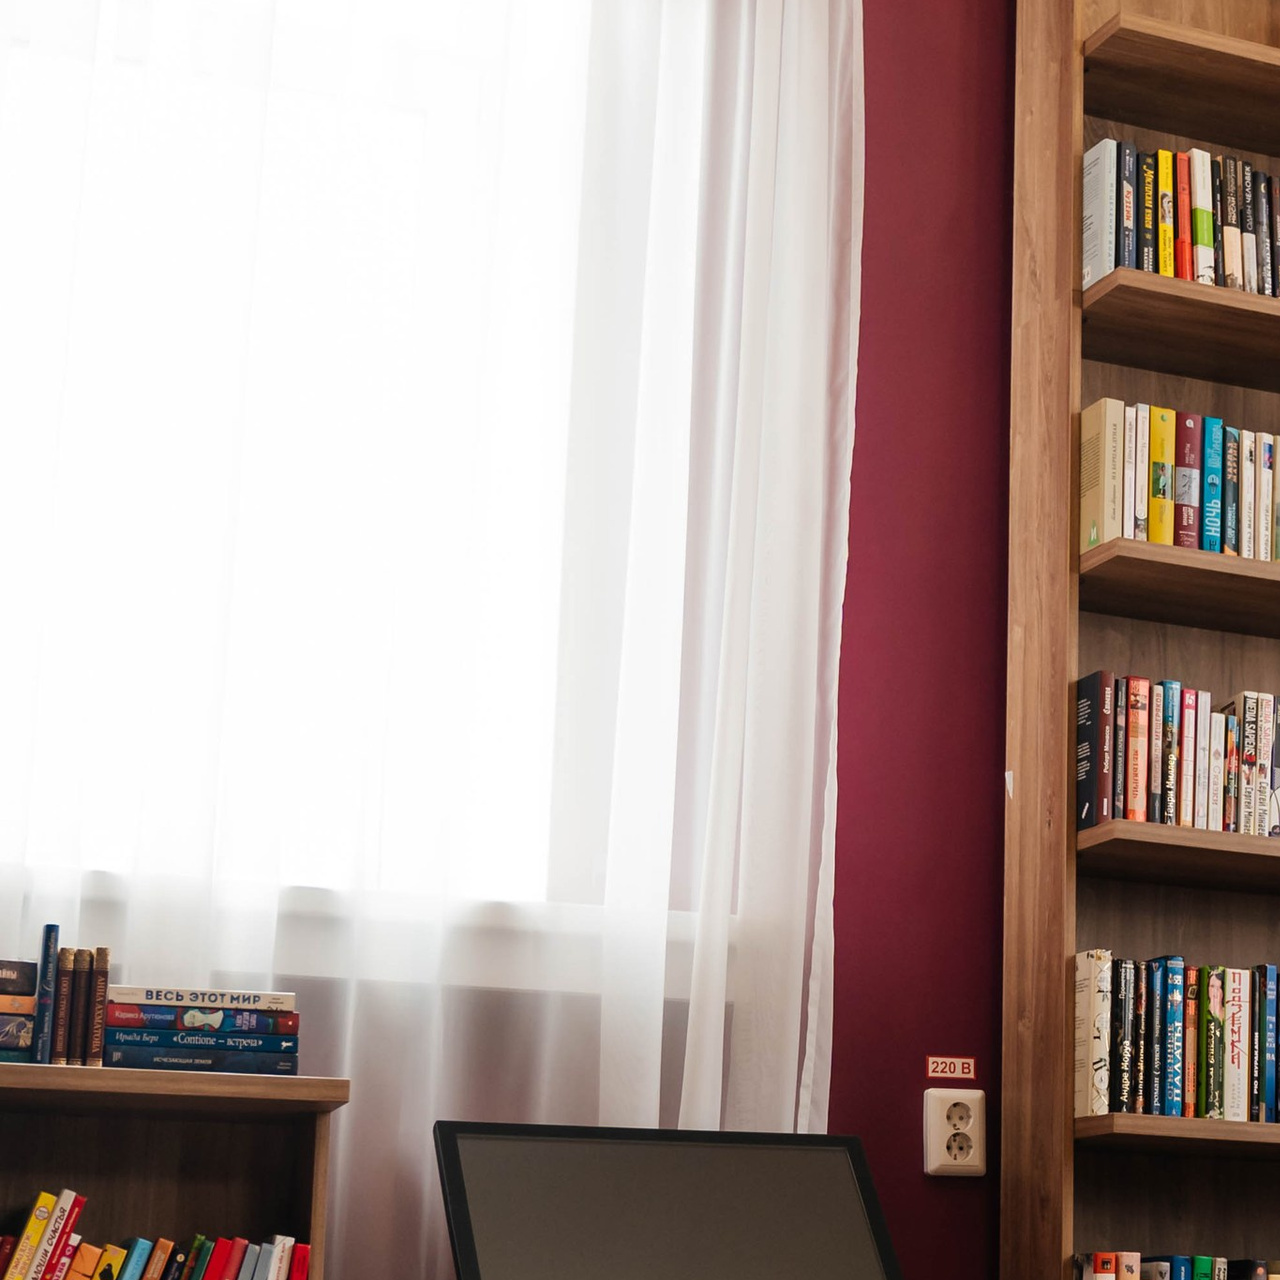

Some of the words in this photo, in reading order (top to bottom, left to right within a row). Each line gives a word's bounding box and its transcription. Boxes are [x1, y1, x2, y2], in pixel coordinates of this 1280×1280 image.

[1244, 166, 1252, 204] ЧЕЛОВЕК
[1246, 205, 1254, 230] ОДИН
[1206, 499, 1221, 538] НОЧЬ
[1246, 699, 1257, 723] MEDIA
[1263, 699, 1272, 726] MEDIA
[1245, 724, 1256, 756] SAPIENS
[1262, 727, 1271, 761] SAPIENS
[1166, 754, 1176, 790] Миллер
[1212, 766, 1222, 806] Сказки
[1244, 787, 1254, 810] Сергей
[1258, 781, 1268, 807] Сергей
[1165, 791, 1176, 818] Генри
[98, 976, 106, 1000] АННА
[145, 990, 184, 1002] ВЕСЬ
[189, 992, 226, 1004] ЭТОТ
[230, 994, 262, 1006] МИР
[92, 1001, 104, 1054] АХМАТОВА
[114, 1010, 138, 1021] Карина
[139, 1011, 176, 1024] Арутюнова
[115, 1032, 144, 1043] Ирада
[146, 1034, 160, 1046] Берг
[173, 1032, 216, 1046] «Contione
[226, 1038, 264, 1049] встреча»
[154, 1056, 194, 1066] ИСЧЕЗАЮЩАЯ
[931, 1061, 956, 1074] 220
[962, 1062, 972, 1075] В
[1122, 1040, 1131, 1070] Моруа
[1174, 1021, 1182, 1102] ПАЛАТЫ
[1120, 1073, 1130, 1102] Андре
[1254, 1080, 1259, 1094] РЮ
[47, 1206, 68, 1248] СЧАСТЬЯ
